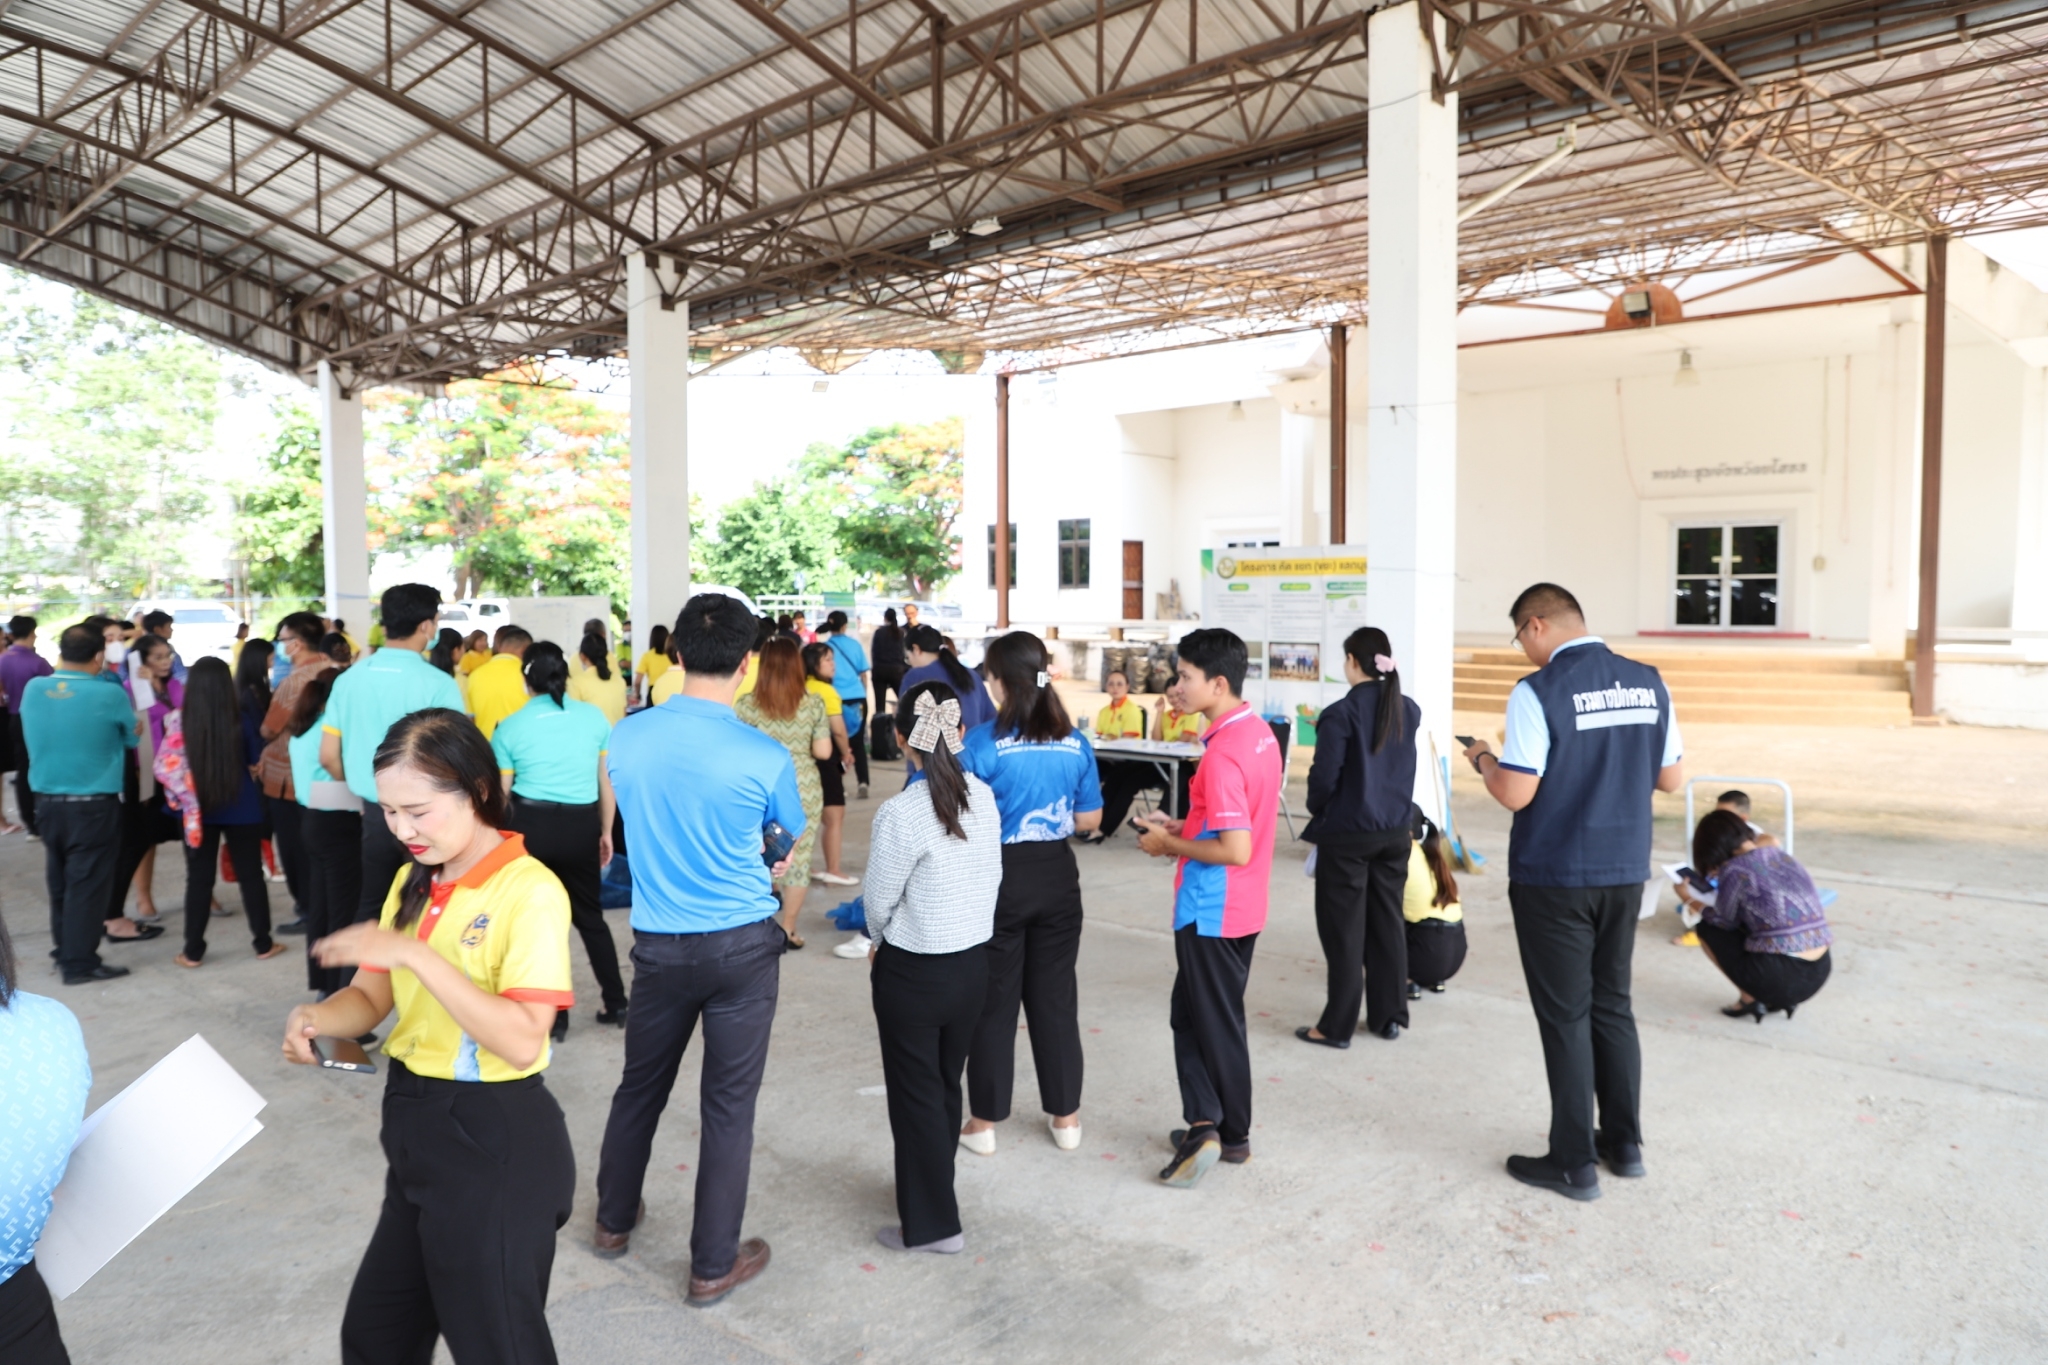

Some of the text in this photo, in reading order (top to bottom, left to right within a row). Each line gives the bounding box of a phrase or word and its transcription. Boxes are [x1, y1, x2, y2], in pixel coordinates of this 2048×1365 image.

[1572, 680, 1658, 713] กรมการปกครอง
